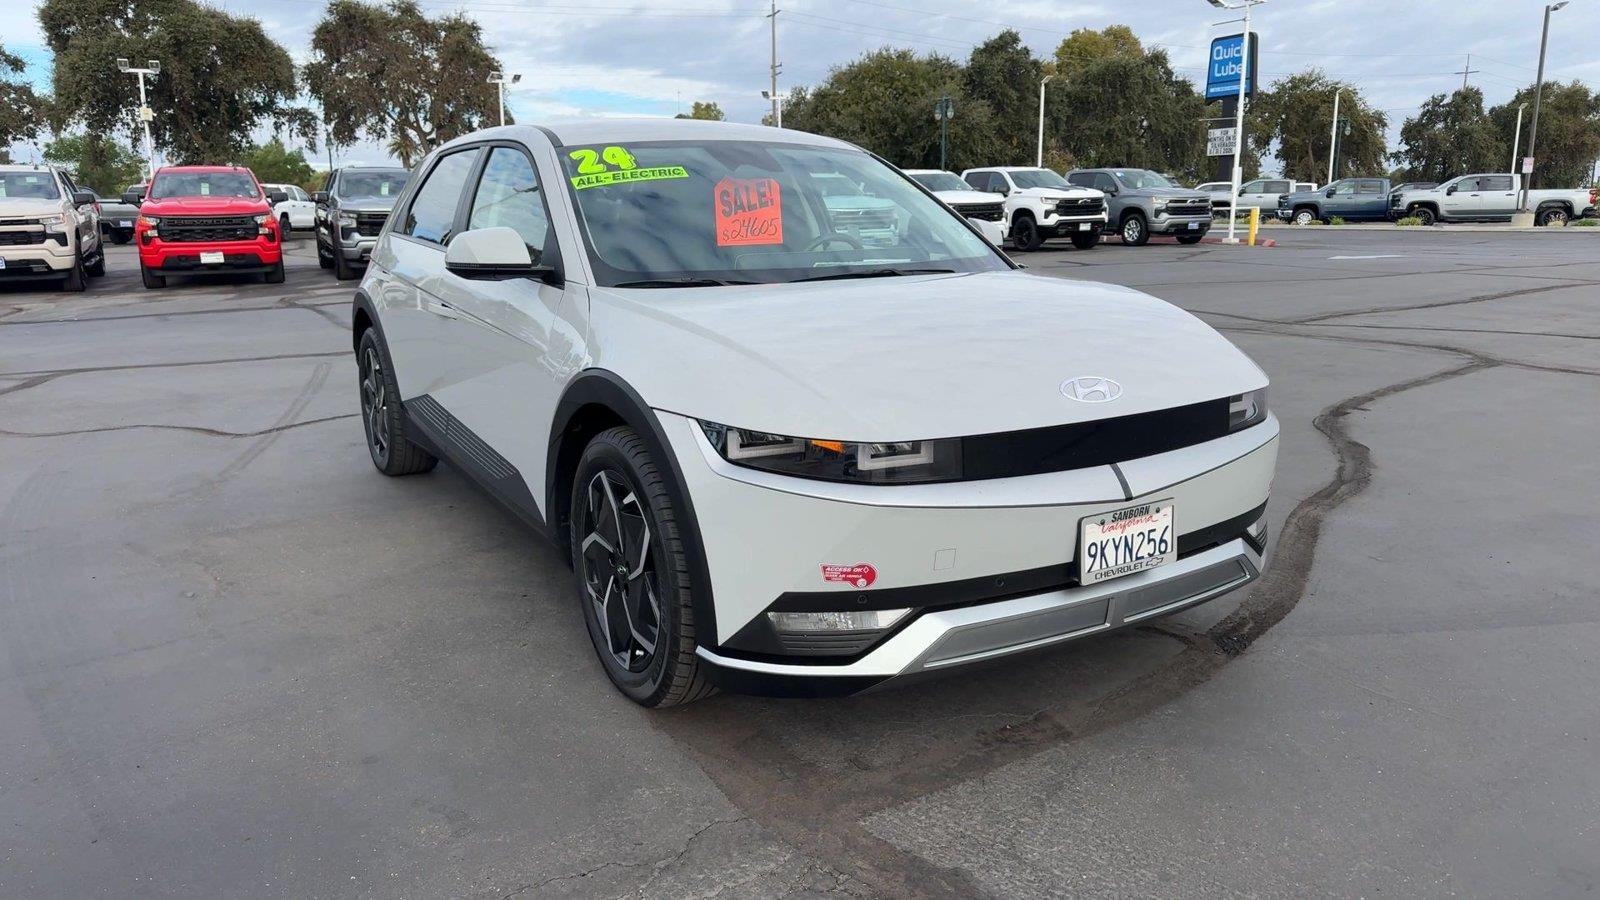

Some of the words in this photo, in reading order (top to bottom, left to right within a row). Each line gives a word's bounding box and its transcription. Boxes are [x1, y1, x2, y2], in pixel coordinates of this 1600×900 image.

[1214, 61, 1242, 77] Lube
[576, 167, 684, 188] ALL-ELECTRIC
[720, 179, 774, 217] SALE!
[723, 217, 779, 242] $24605
[1111, 505, 1151, 522] SANBORN
[1087, 525, 1169, 573] 9KYN256
[1095, 561, 1143, 580] CHEVROLET
